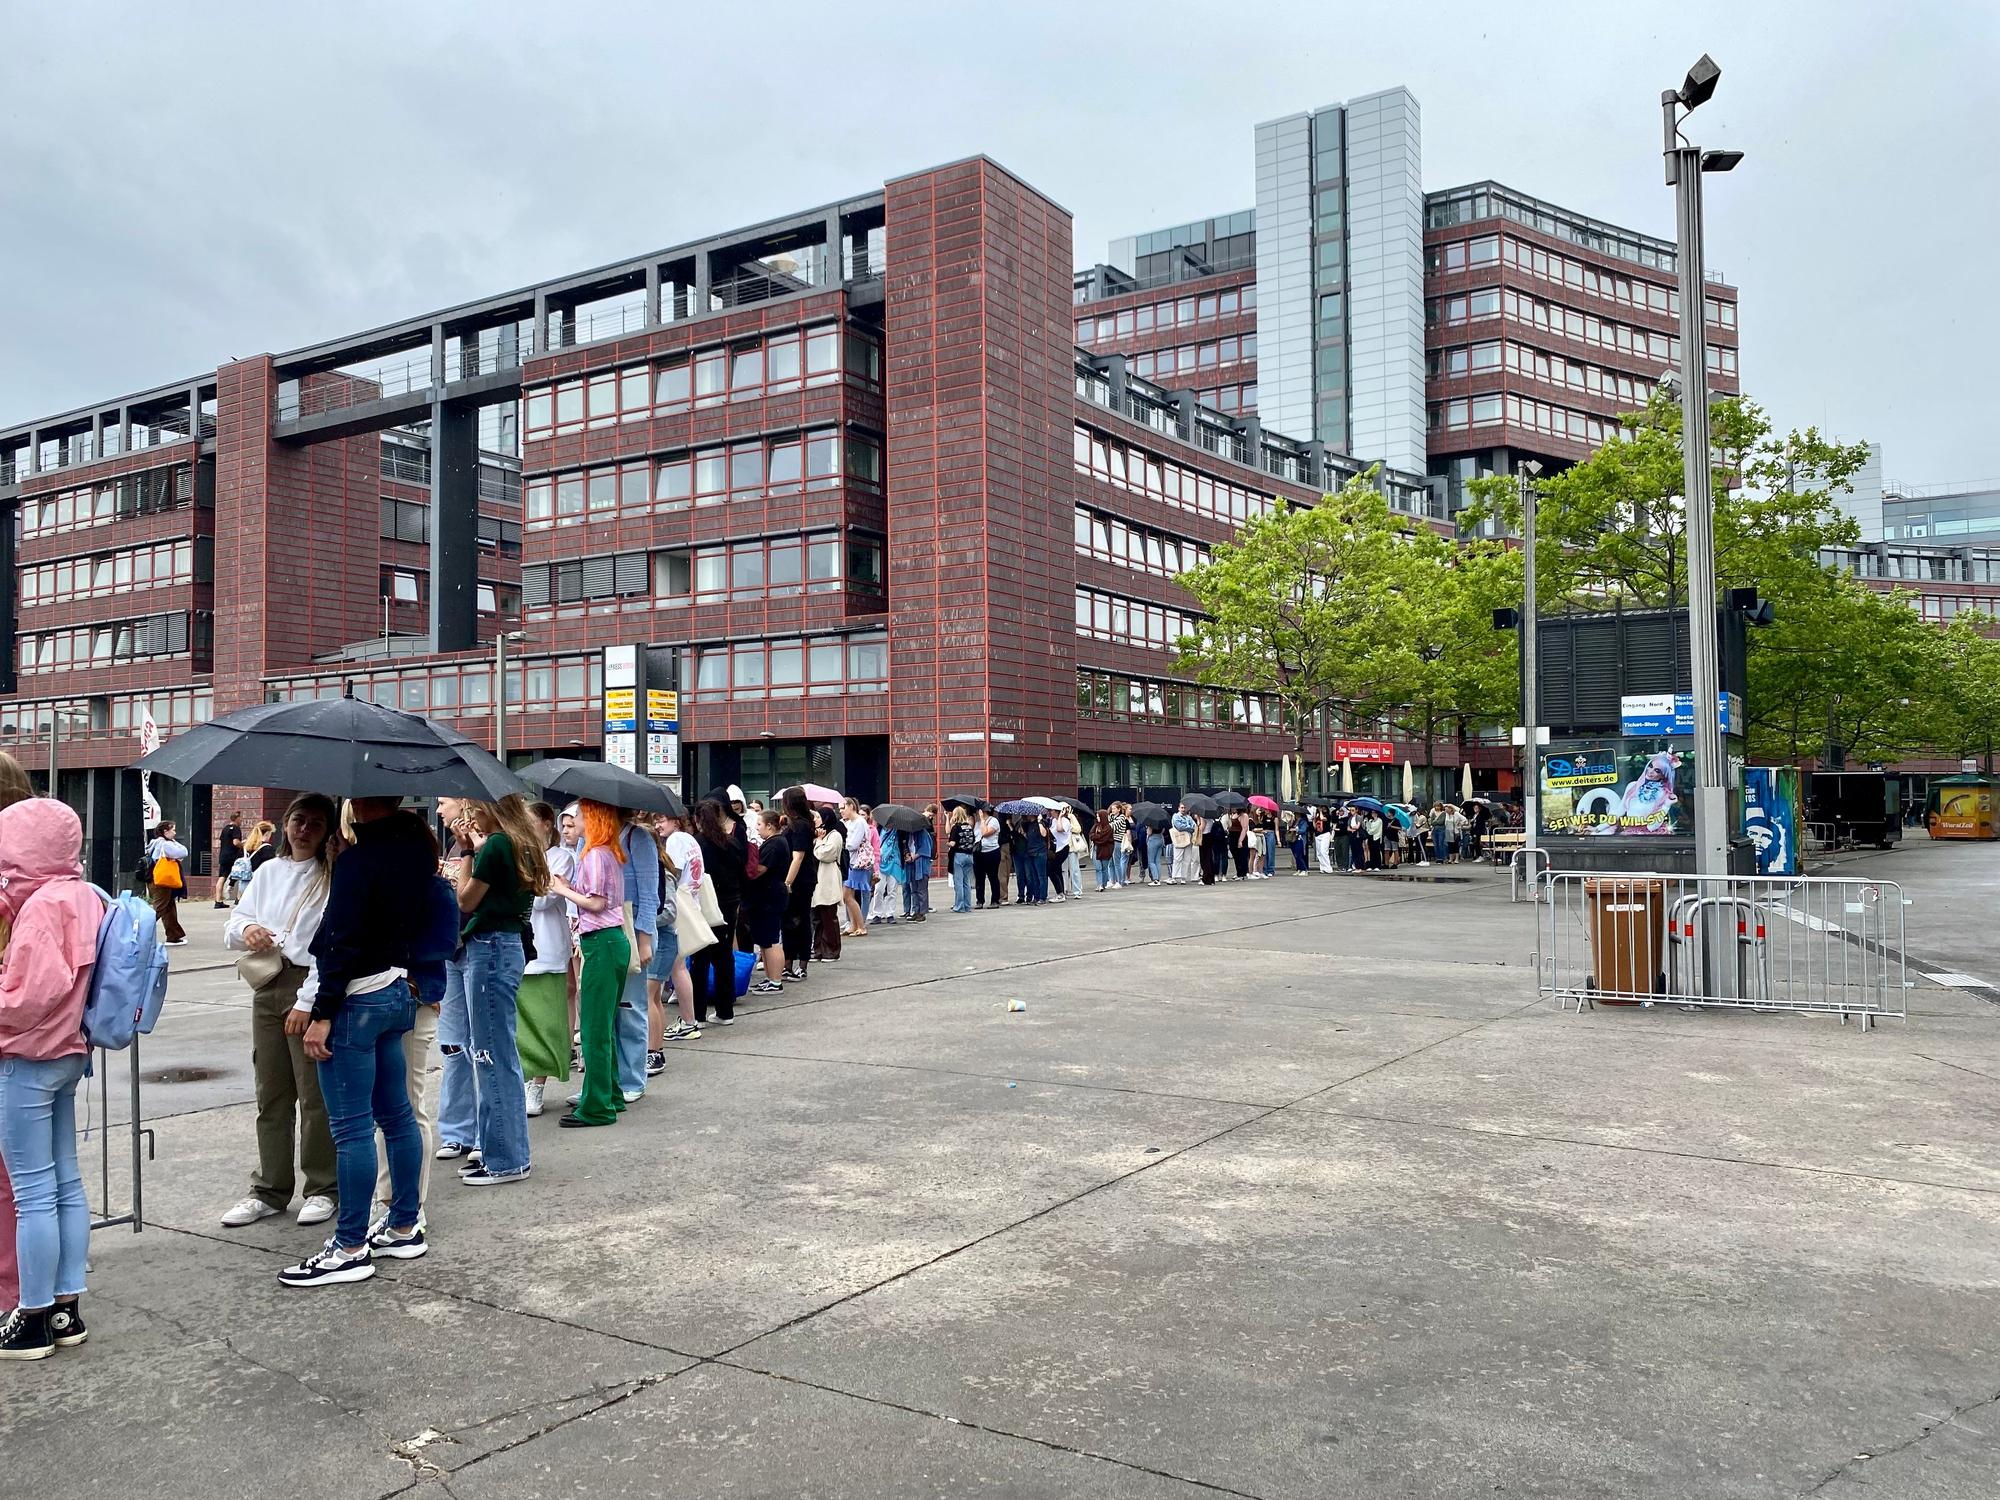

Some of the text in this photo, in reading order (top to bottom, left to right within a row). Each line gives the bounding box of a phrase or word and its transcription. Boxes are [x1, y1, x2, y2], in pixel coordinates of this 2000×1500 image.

[1547, 759, 1615, 777] DEITERS
[1551, 775, 1614, 786] www.deiters.de
[1548, 809, 1669, 831] SEI WER DU WILLST!
